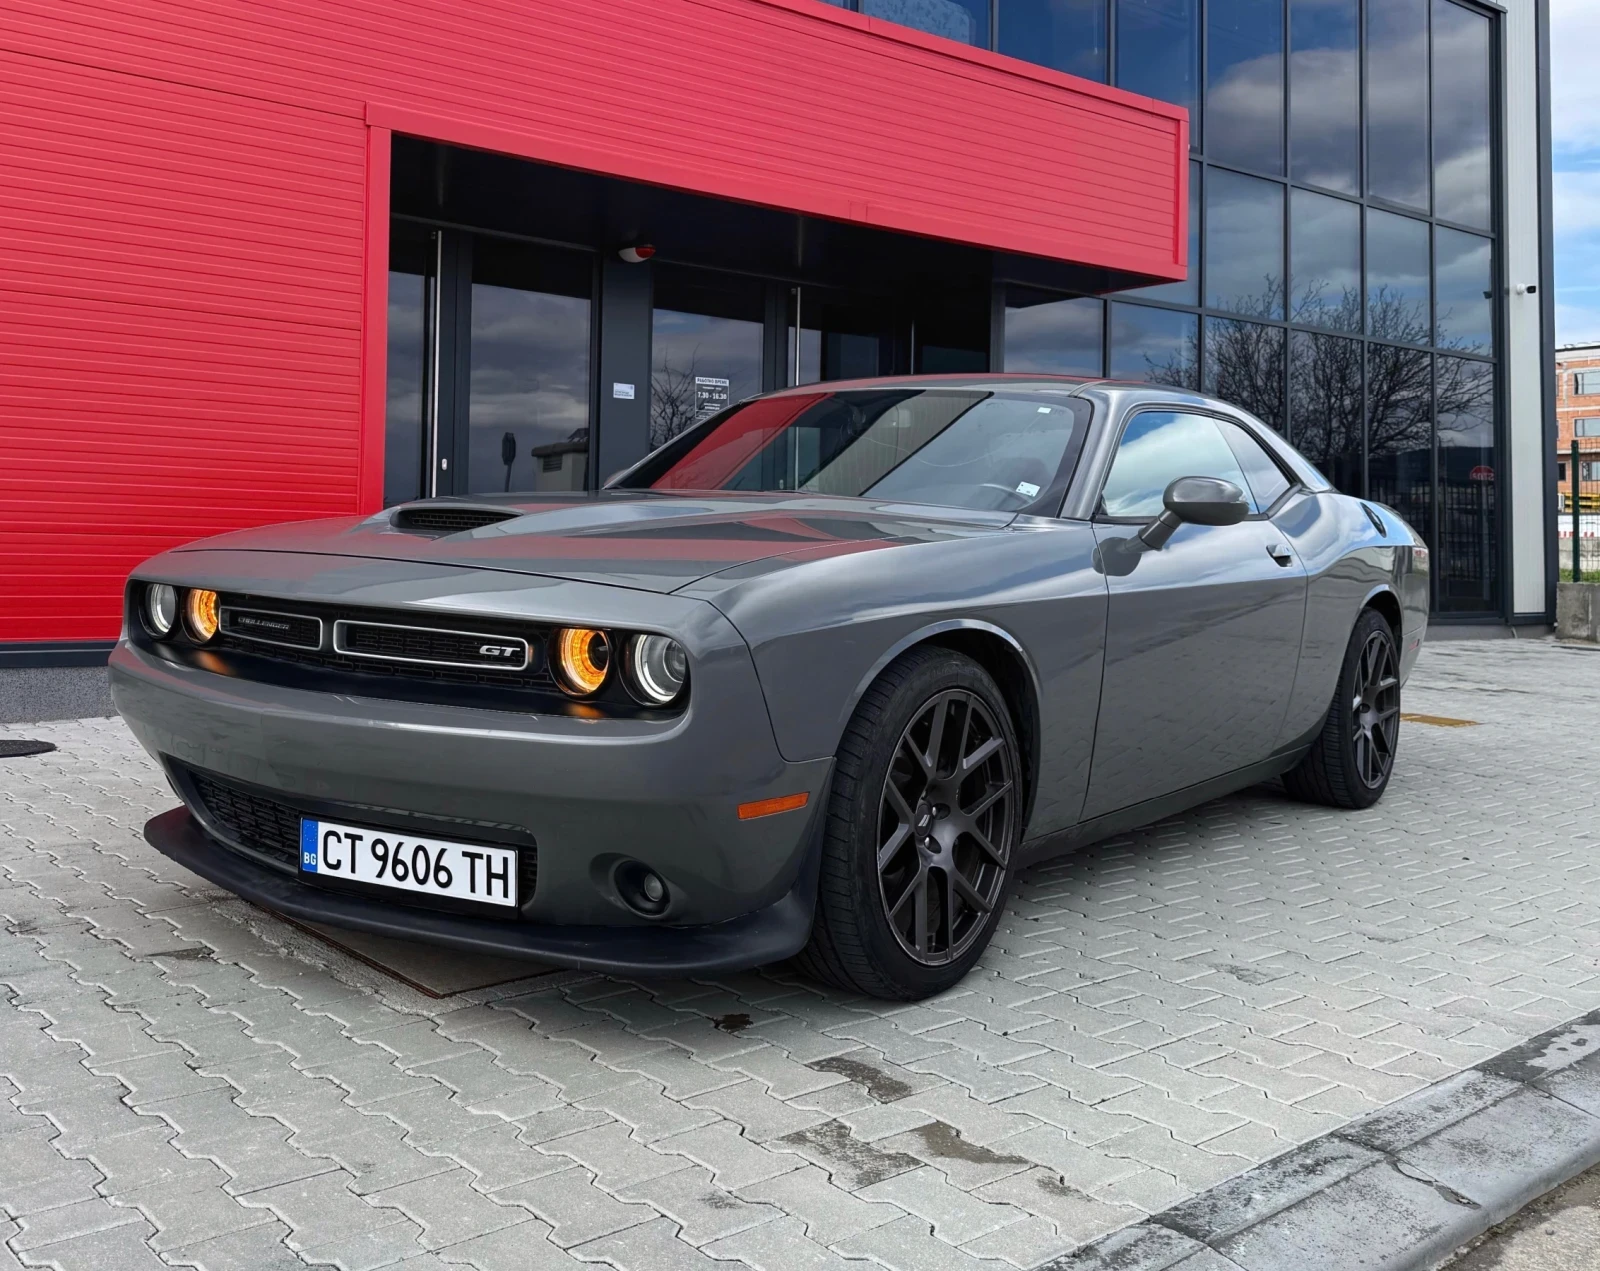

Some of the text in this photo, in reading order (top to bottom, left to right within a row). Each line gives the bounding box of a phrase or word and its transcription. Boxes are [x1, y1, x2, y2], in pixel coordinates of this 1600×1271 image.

[697, 391, 709, 399] 7.30
[238, 616, 290, 630] CHALLENGER
[479, 645, 520, 657] GT
[303, 852, 317, 865] BG
[323, 830, 509, 899] CT 9606 TH
